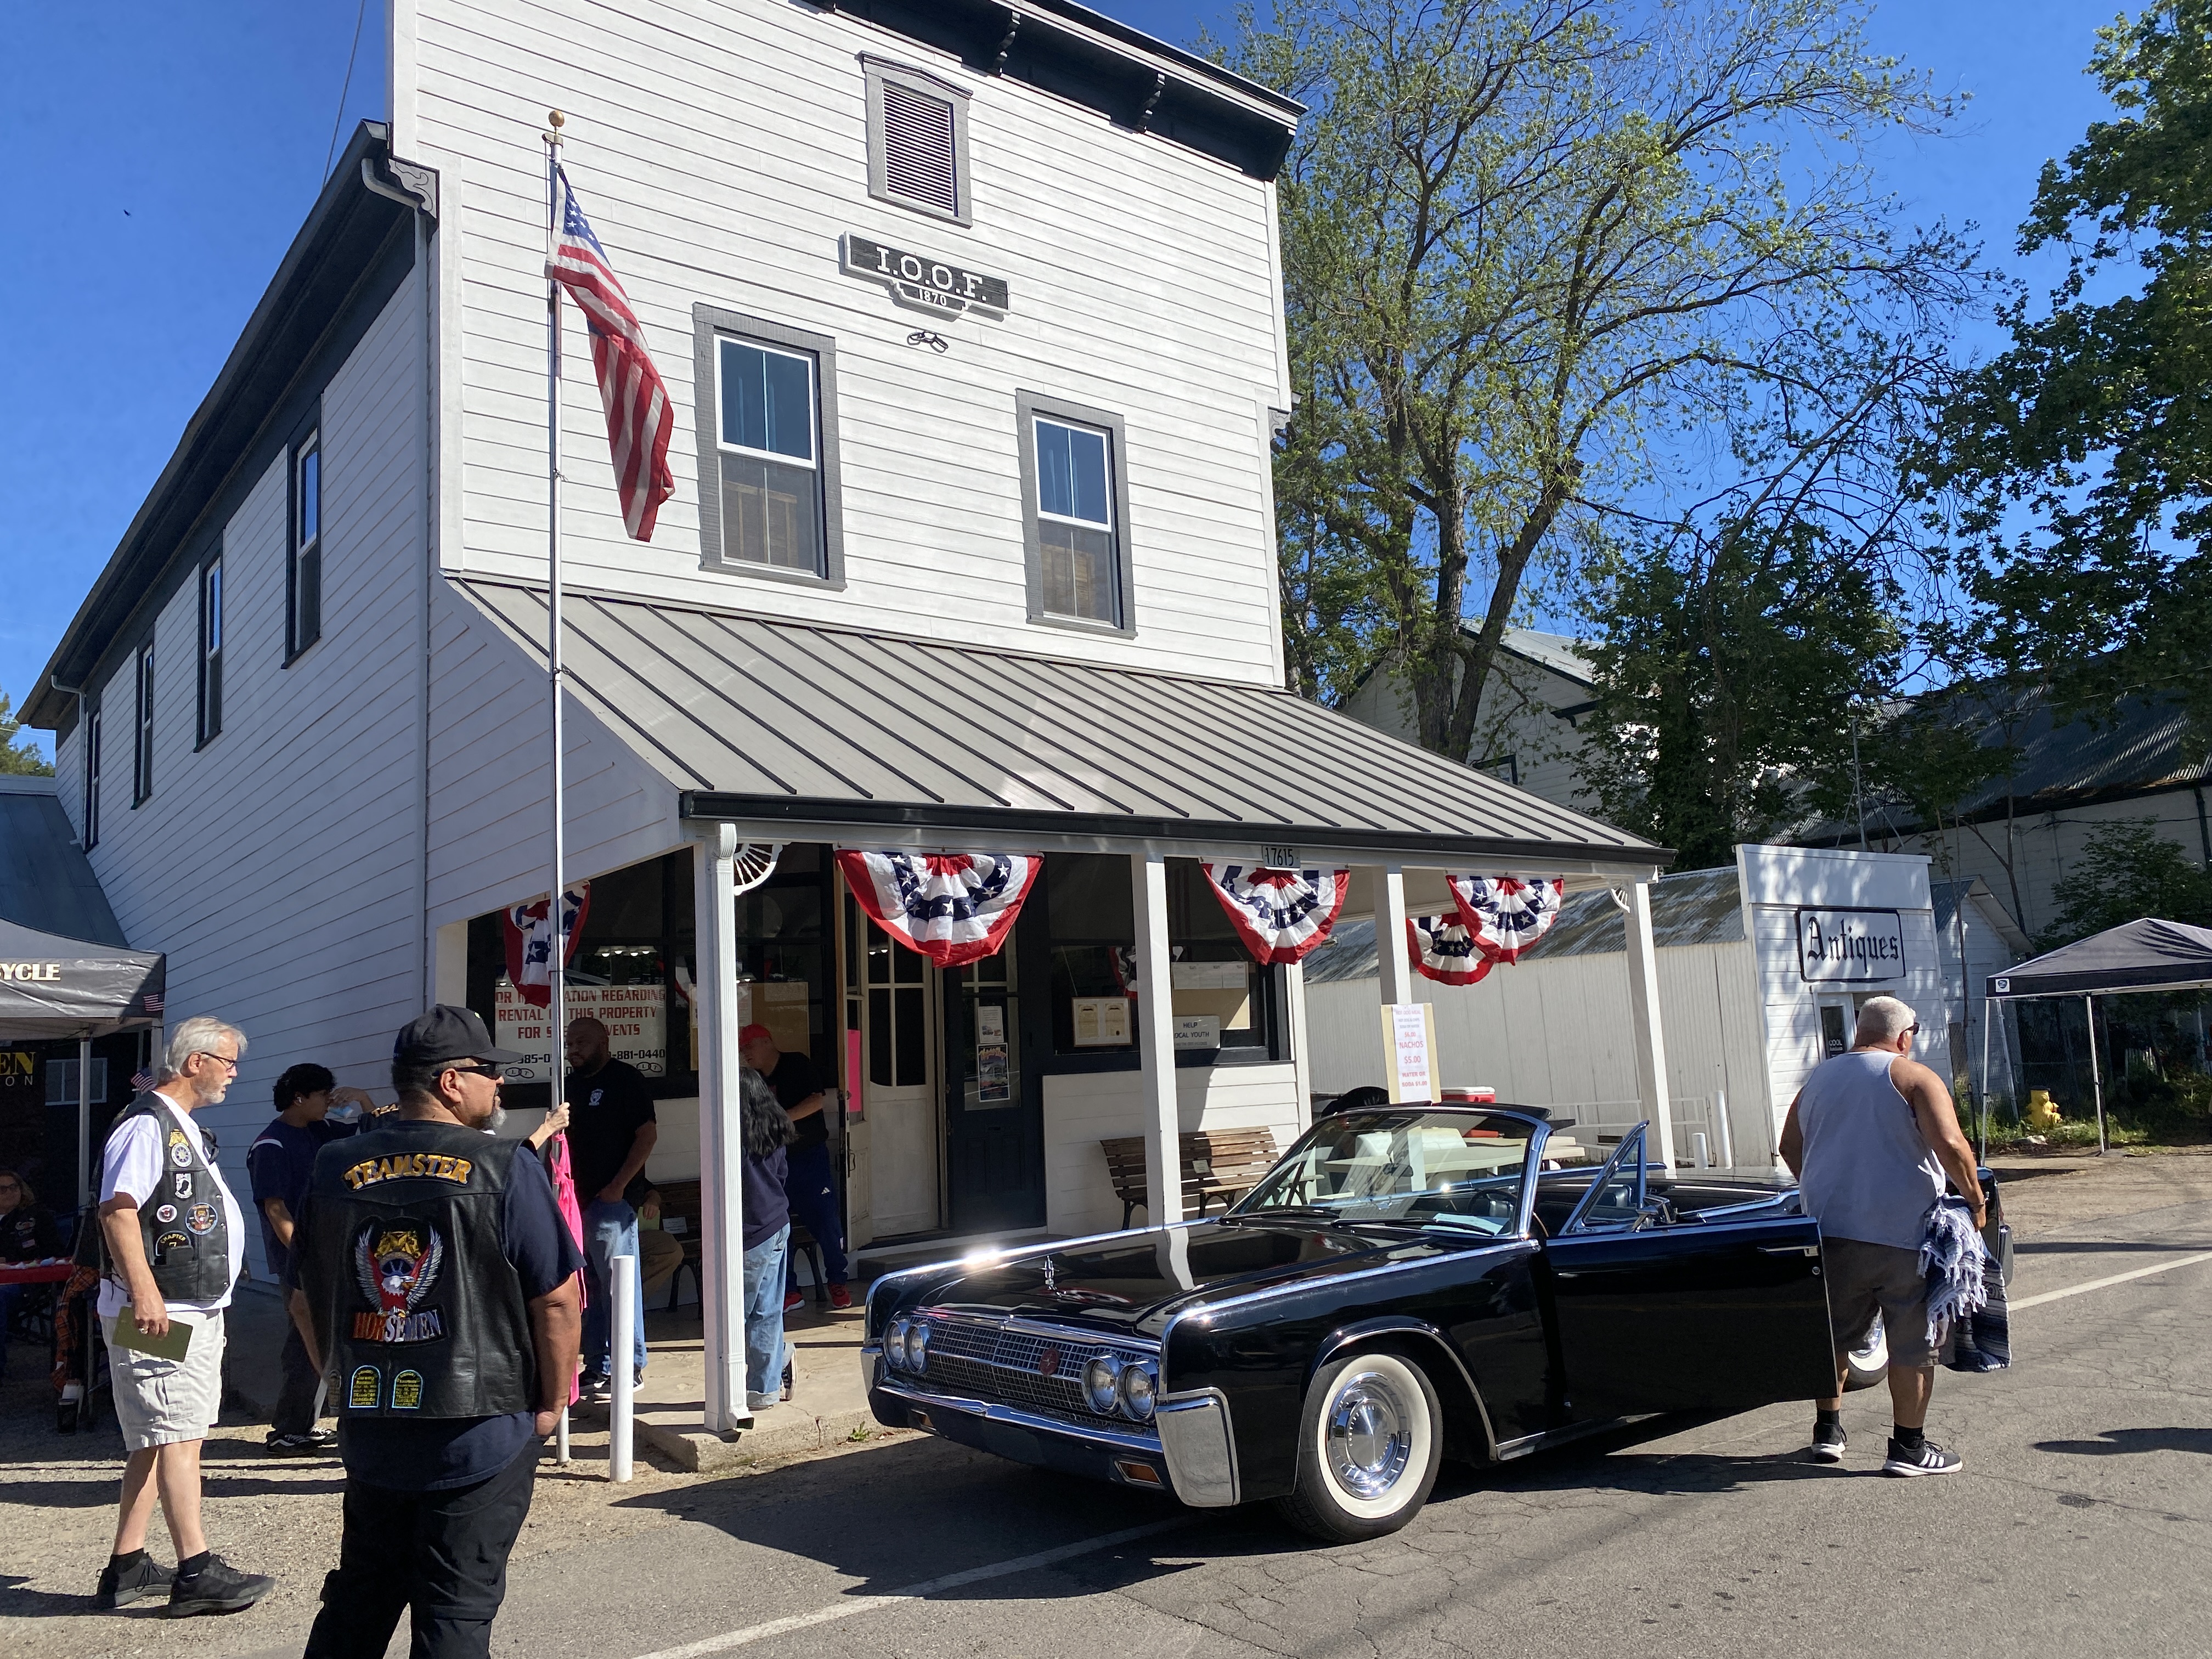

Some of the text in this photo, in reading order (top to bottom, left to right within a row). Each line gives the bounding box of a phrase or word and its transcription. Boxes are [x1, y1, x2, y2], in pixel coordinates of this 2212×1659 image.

[876, 246, 987, 301] I.O.O.F.
[918, 289, 947, 306] 1870
[1265, 847, 1294, 866] 17615
[1807, 916, 1899, 974] Antiques
[0, 963, 61, 981] YCLE
[495, 991, 512, 1003] OR
[498, 1009, 544, 1022] RENTAL
[568, 1008, 594, 1019] THIS
[599, 1006, 657, 1019] PROPERTY
[518, 1026, 540, 1039] FOR
[605, 1024, 640, 1036] VENTS
[1400, 1041, 1424, 1049] NACHOS
[609, 1049, 665, 1060] -881-0440
[1404, 1056, 1421, 1064] $5.00
[344, 1154, 472, 1189] TEAMSTER
[160, 1233, 187, 1244] CHAPTER
